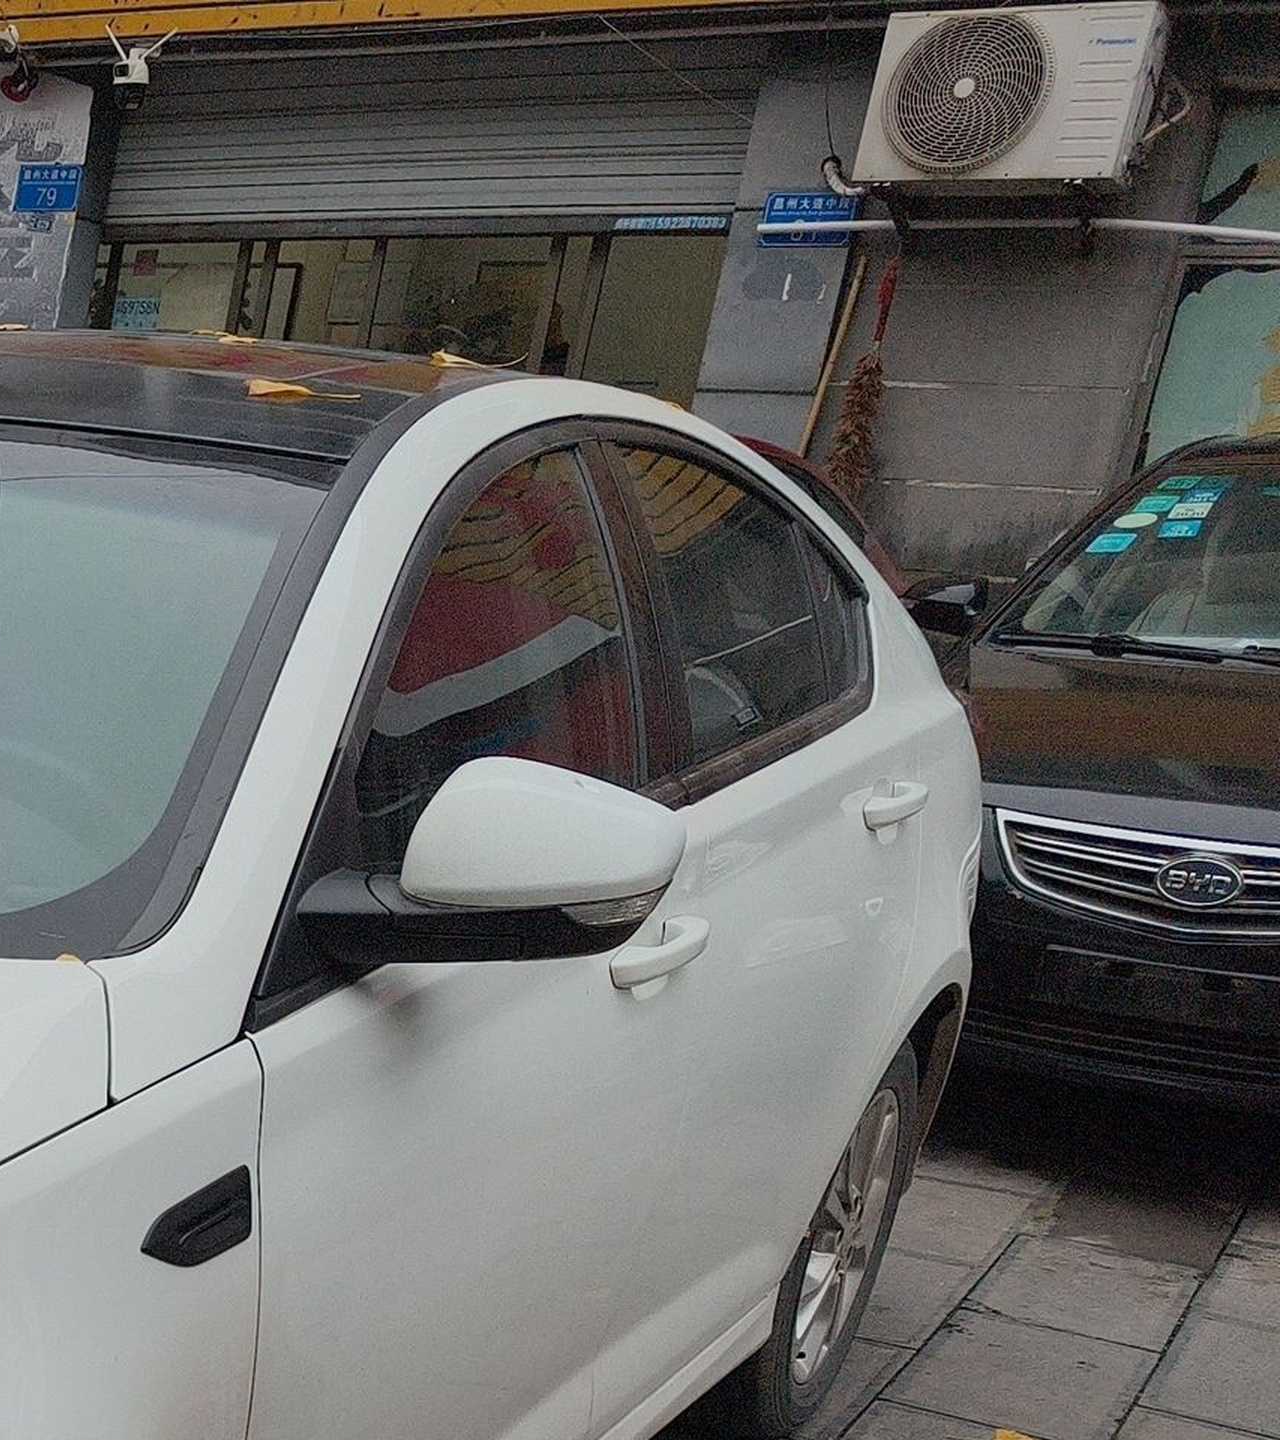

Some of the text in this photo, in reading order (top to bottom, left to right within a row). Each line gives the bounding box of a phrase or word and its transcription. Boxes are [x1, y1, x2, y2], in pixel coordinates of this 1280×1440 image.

[36, 187, 58, 207] 79
[772, 197, 850, 211] 昌州大道中段
[1165, 868, 1232, 895] BYD
